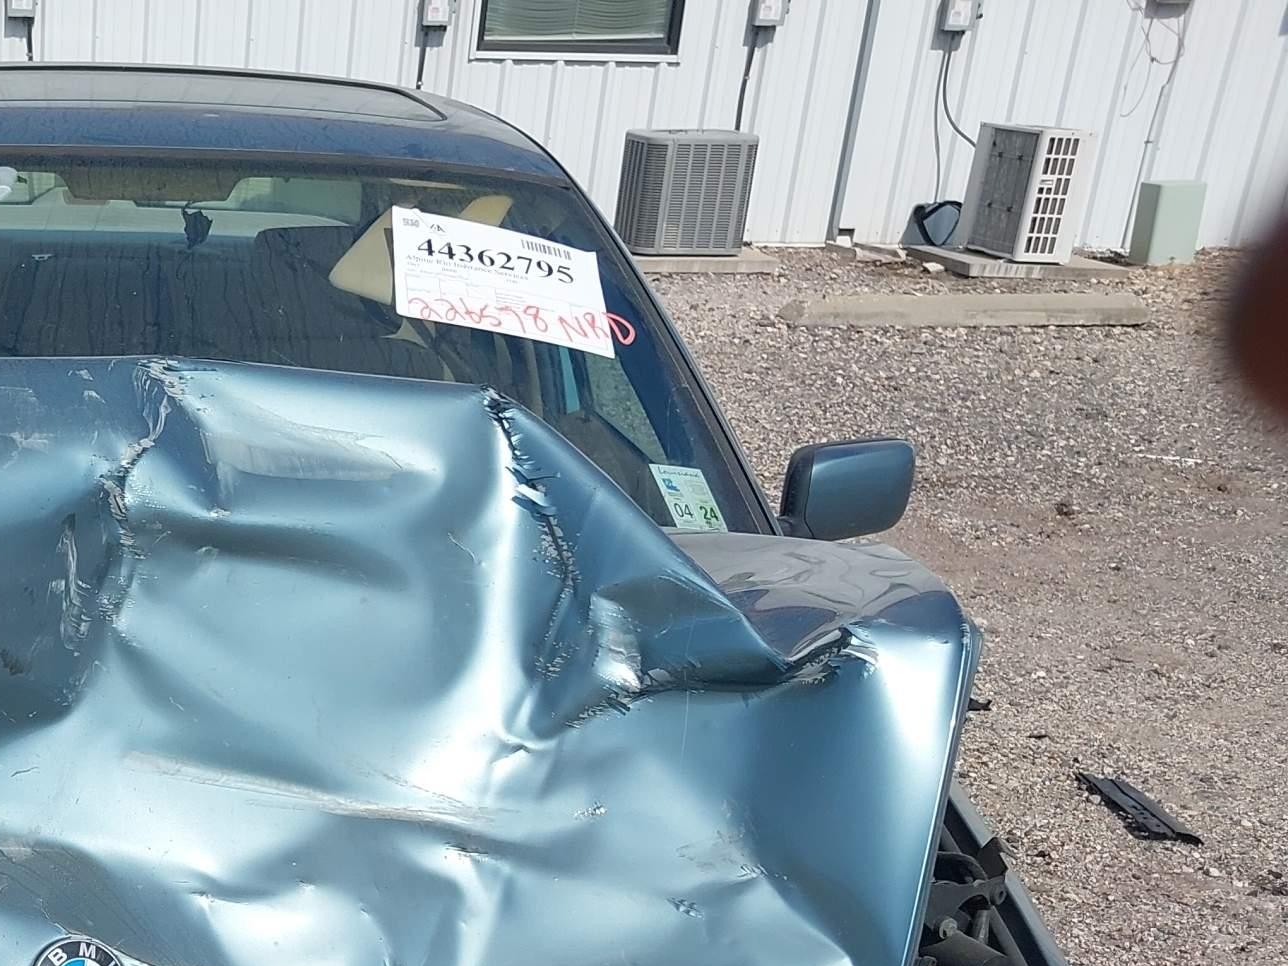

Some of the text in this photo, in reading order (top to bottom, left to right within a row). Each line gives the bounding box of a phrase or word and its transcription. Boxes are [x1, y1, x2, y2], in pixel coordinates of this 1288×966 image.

[417, 238, 574, 285] 44362795
[673, 502, 720, 522] 04 24
